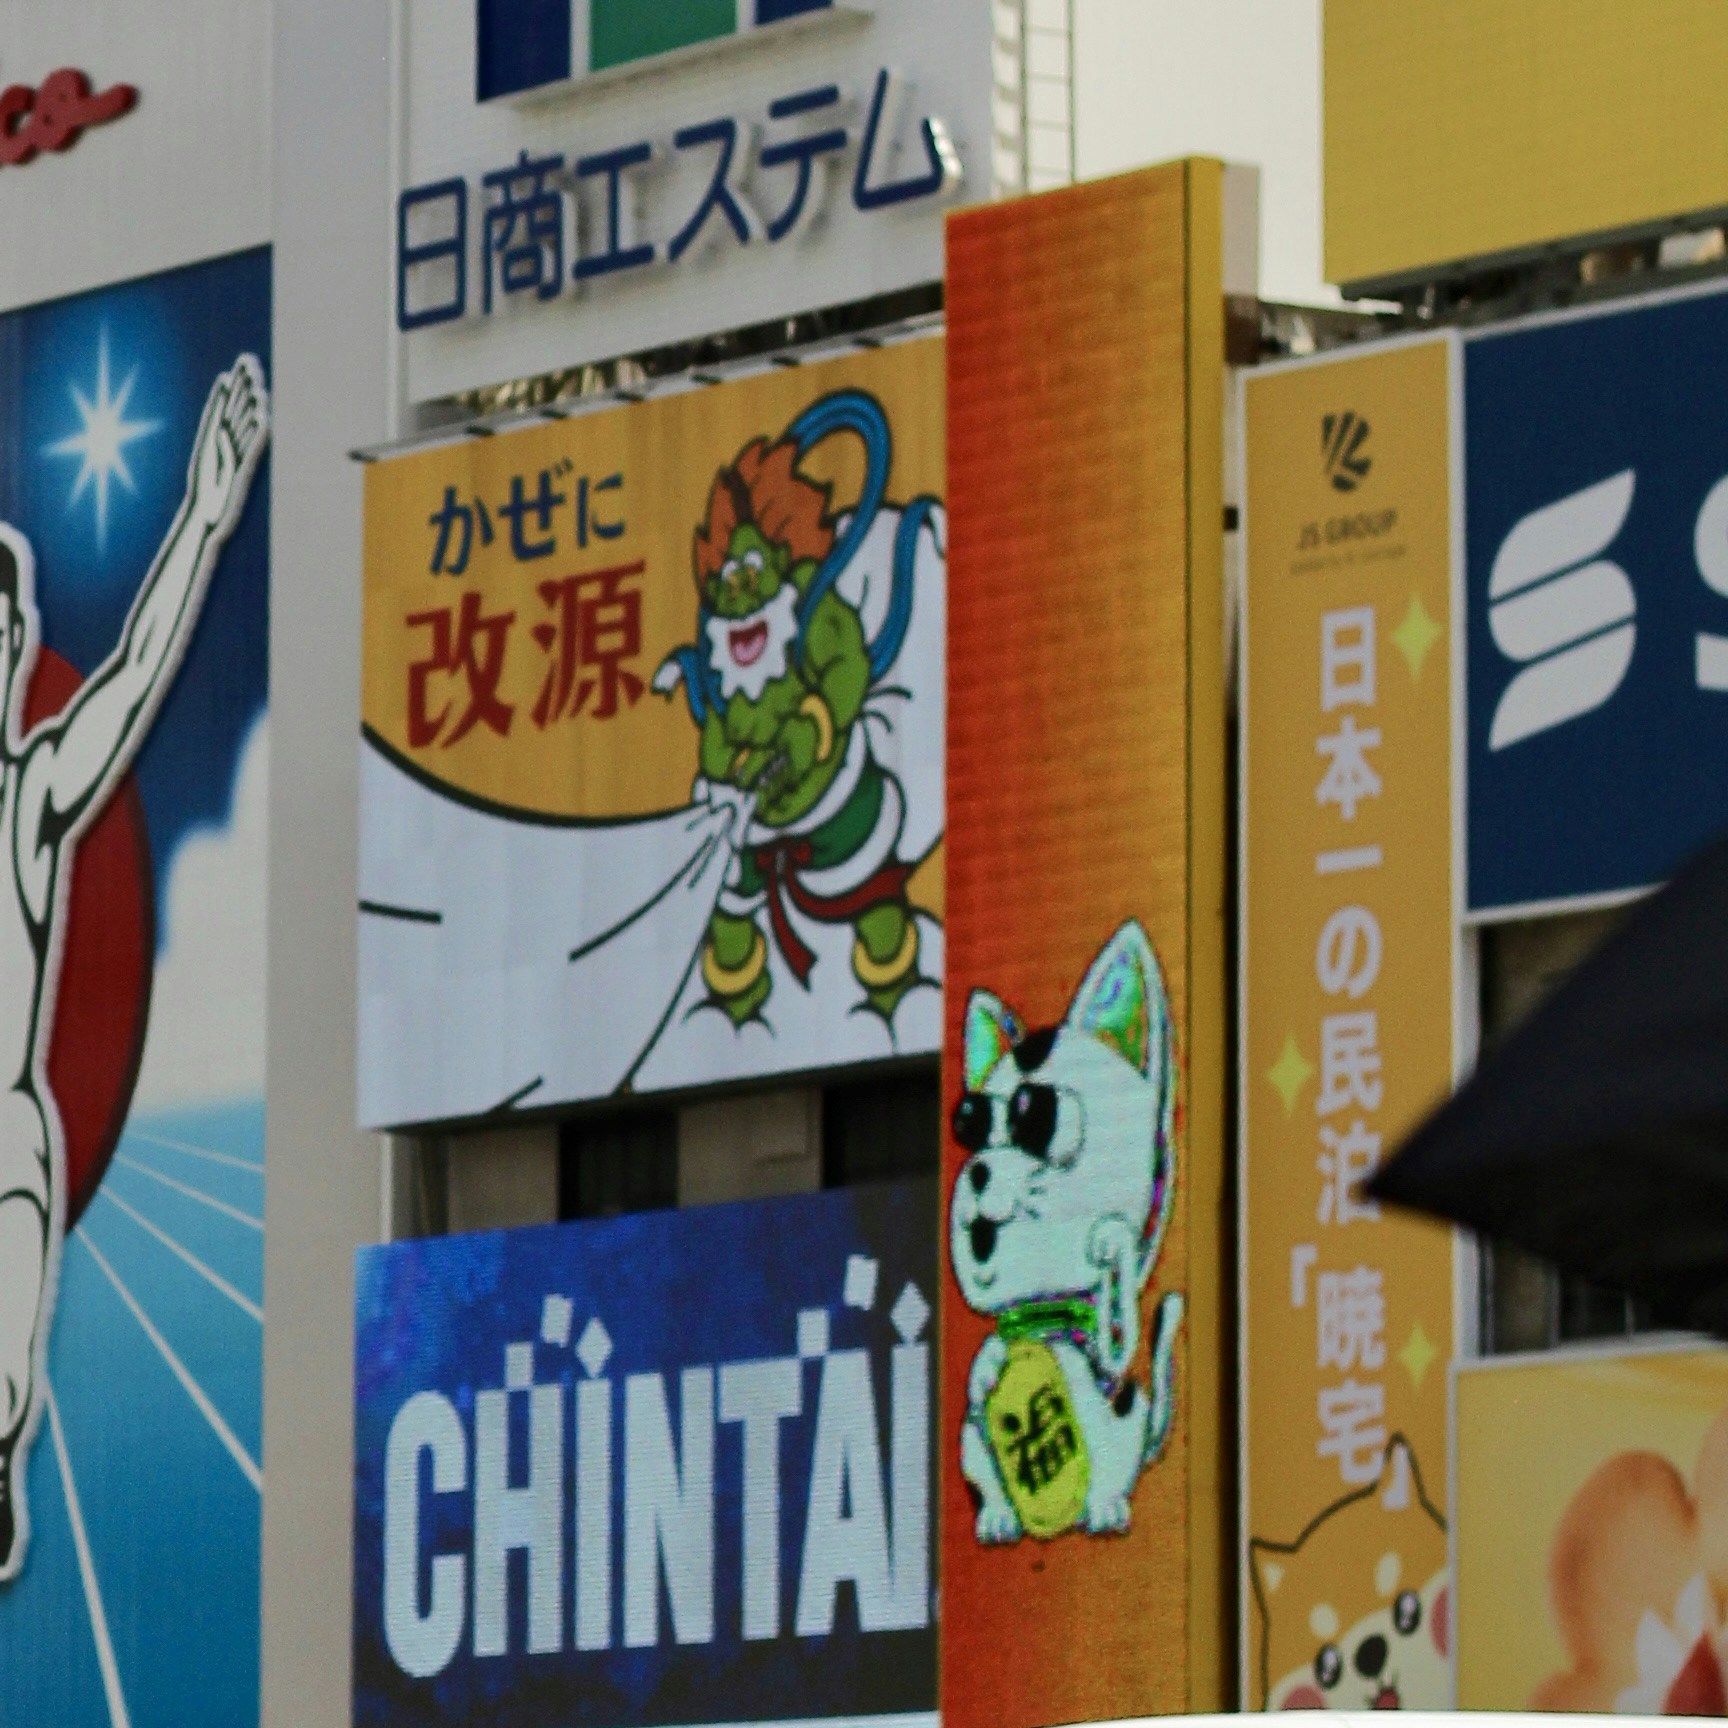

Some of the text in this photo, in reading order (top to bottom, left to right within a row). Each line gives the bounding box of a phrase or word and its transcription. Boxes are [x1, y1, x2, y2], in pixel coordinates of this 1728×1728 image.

[396, 68, 956, 332] 日商エステム
[428, 458, 627, 577] かぜに
[404, 558, 647, 750] 改源
[383, 1256, 932, 1678] CHINTAI
